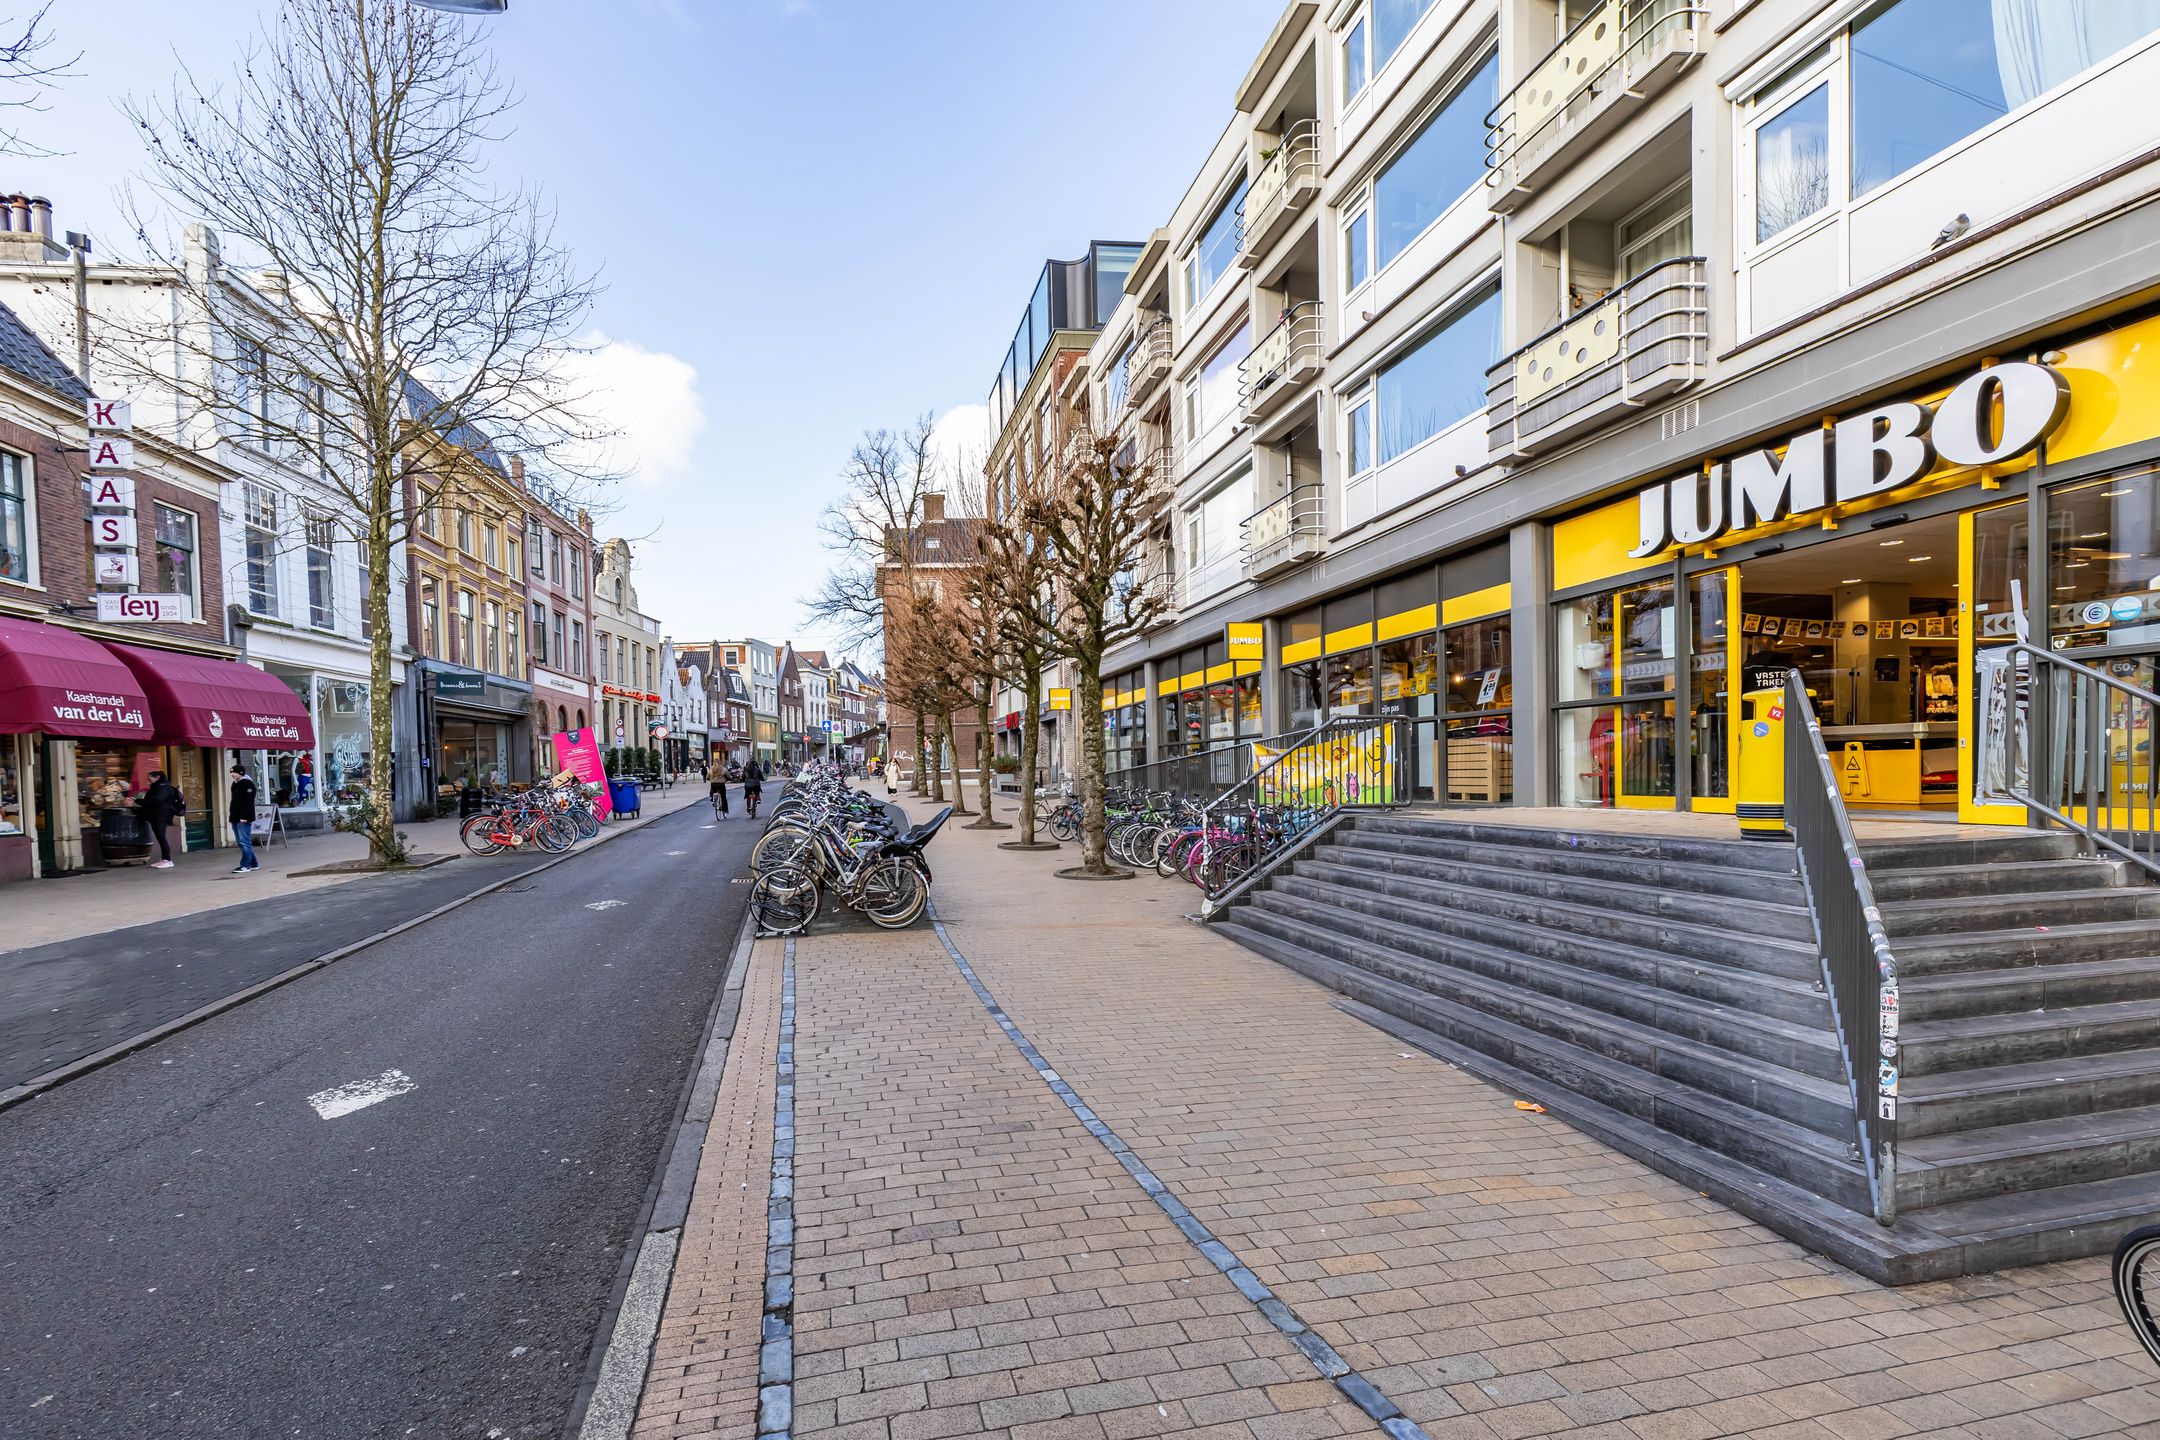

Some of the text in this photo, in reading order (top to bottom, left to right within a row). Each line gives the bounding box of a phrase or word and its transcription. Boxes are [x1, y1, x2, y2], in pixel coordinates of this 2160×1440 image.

[1628, 362, 2071, 559] JUMBO
[94, 402, 120, 542] KAAS
[1755, 671, 1785, 679] VASTE
[65, 690, 125, 707] Kaashandel
[53, 706, 144, 728] van der Leij
[1381, 705, 1390, 715] zijn
[250, 714, 287, 725] Kaashandel
[243, 725, 299, 741] van der Leij
